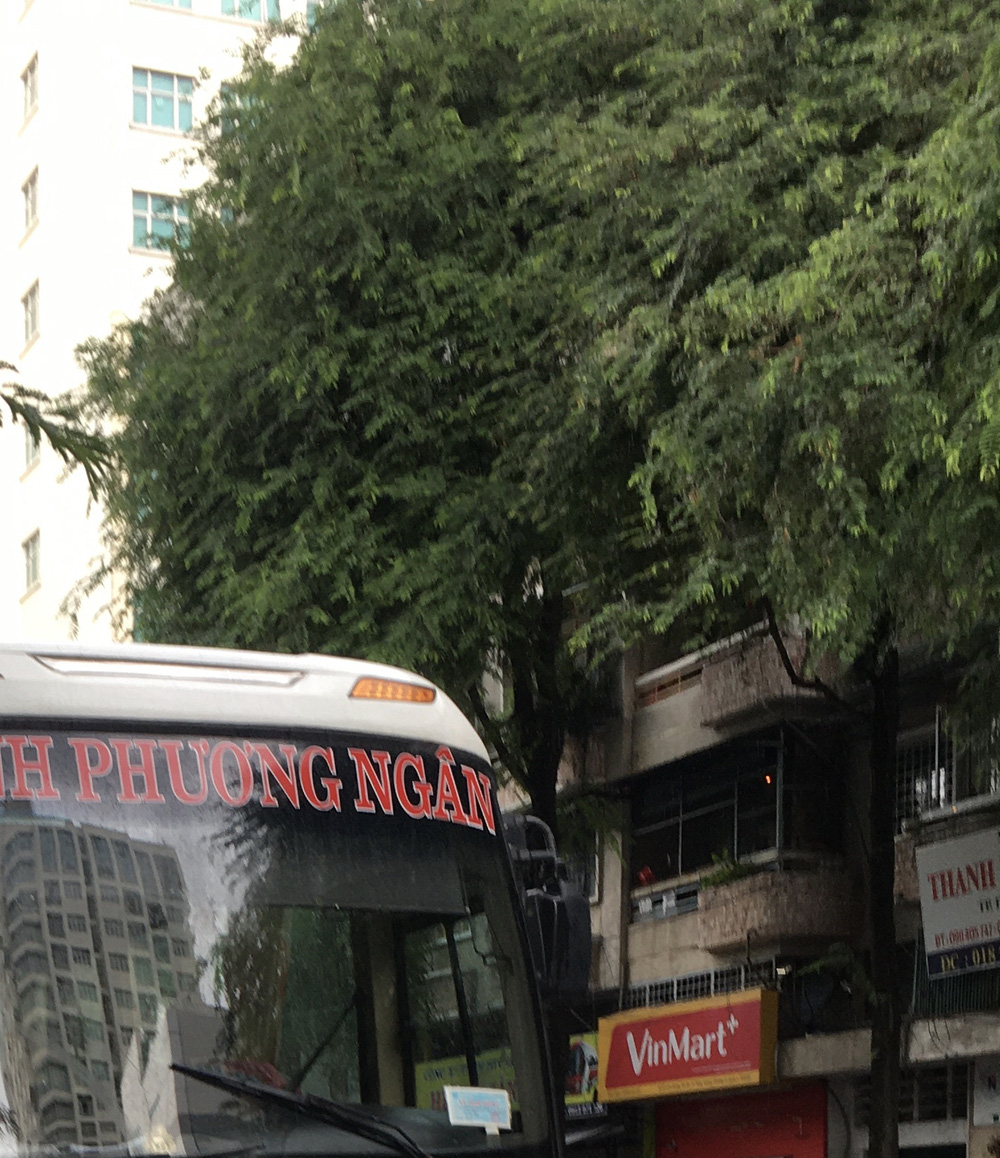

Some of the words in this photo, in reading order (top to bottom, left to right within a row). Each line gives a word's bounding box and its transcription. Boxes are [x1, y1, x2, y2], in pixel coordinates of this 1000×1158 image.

[66, 735, 342, 813] PHƯƠNG
[347, 746, 498, 837] NGÂN
[927, 859, 996, 900] THANH
